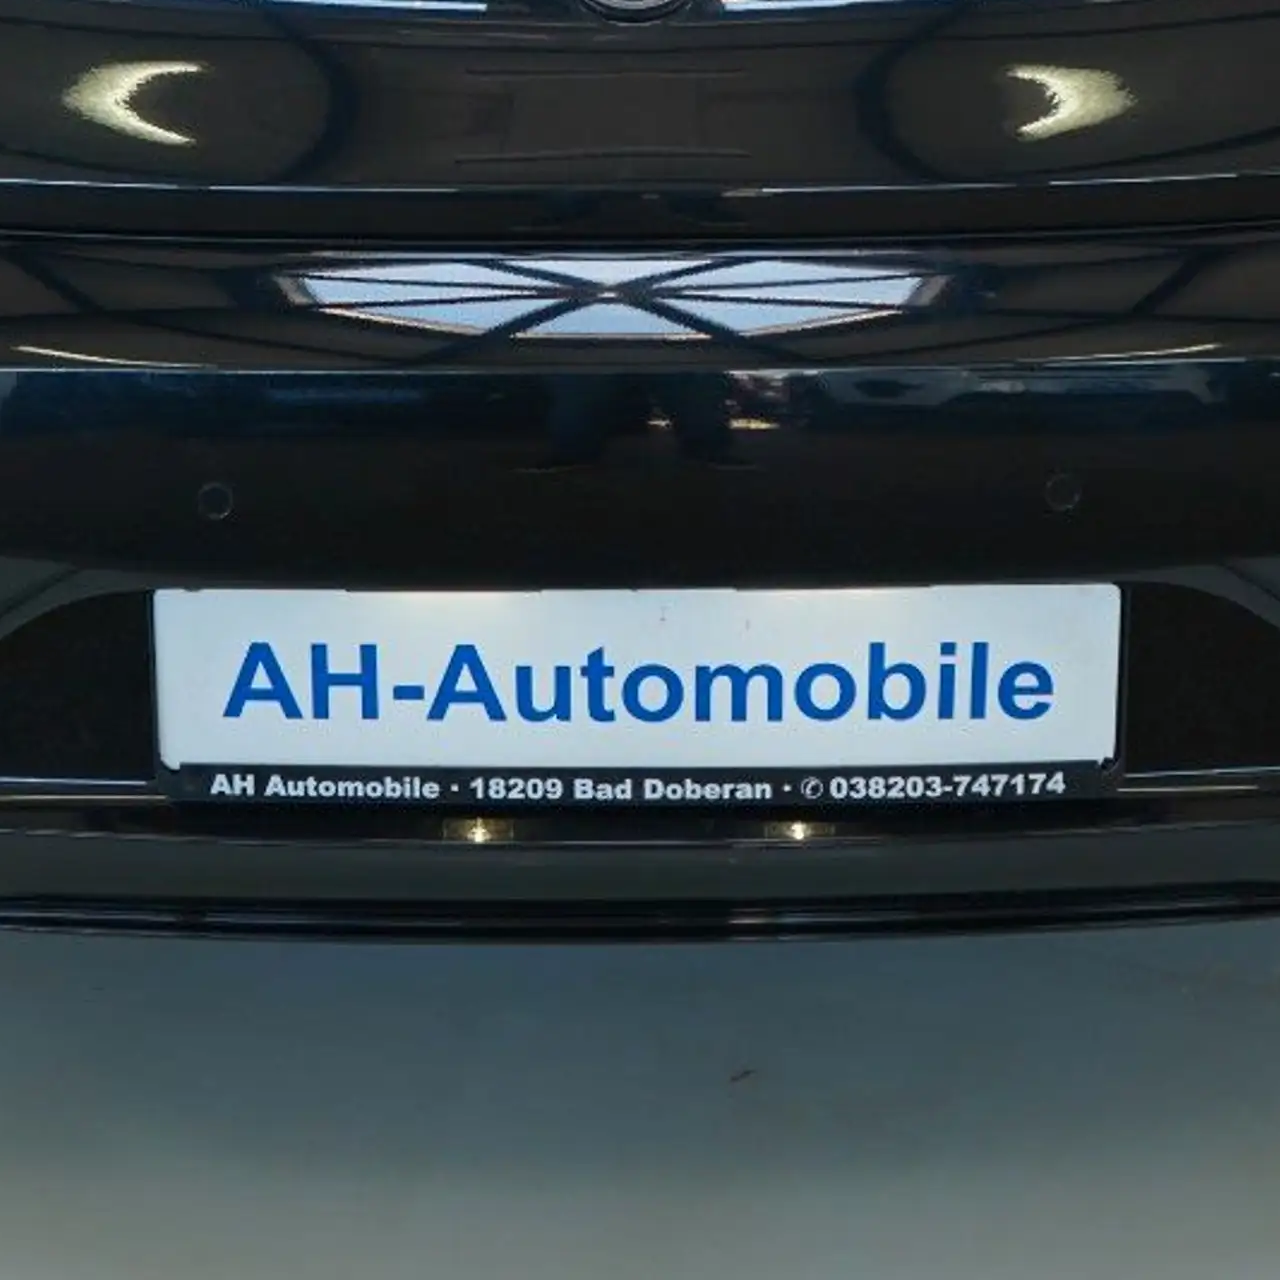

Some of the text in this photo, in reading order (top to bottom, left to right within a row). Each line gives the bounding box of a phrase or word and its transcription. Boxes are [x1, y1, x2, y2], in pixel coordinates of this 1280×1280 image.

[222, 641, 1054, 722] AH-Automobile
[210, 771, 1066, 800] AH Automobile 18209 Bad Doberan 038203-747174
